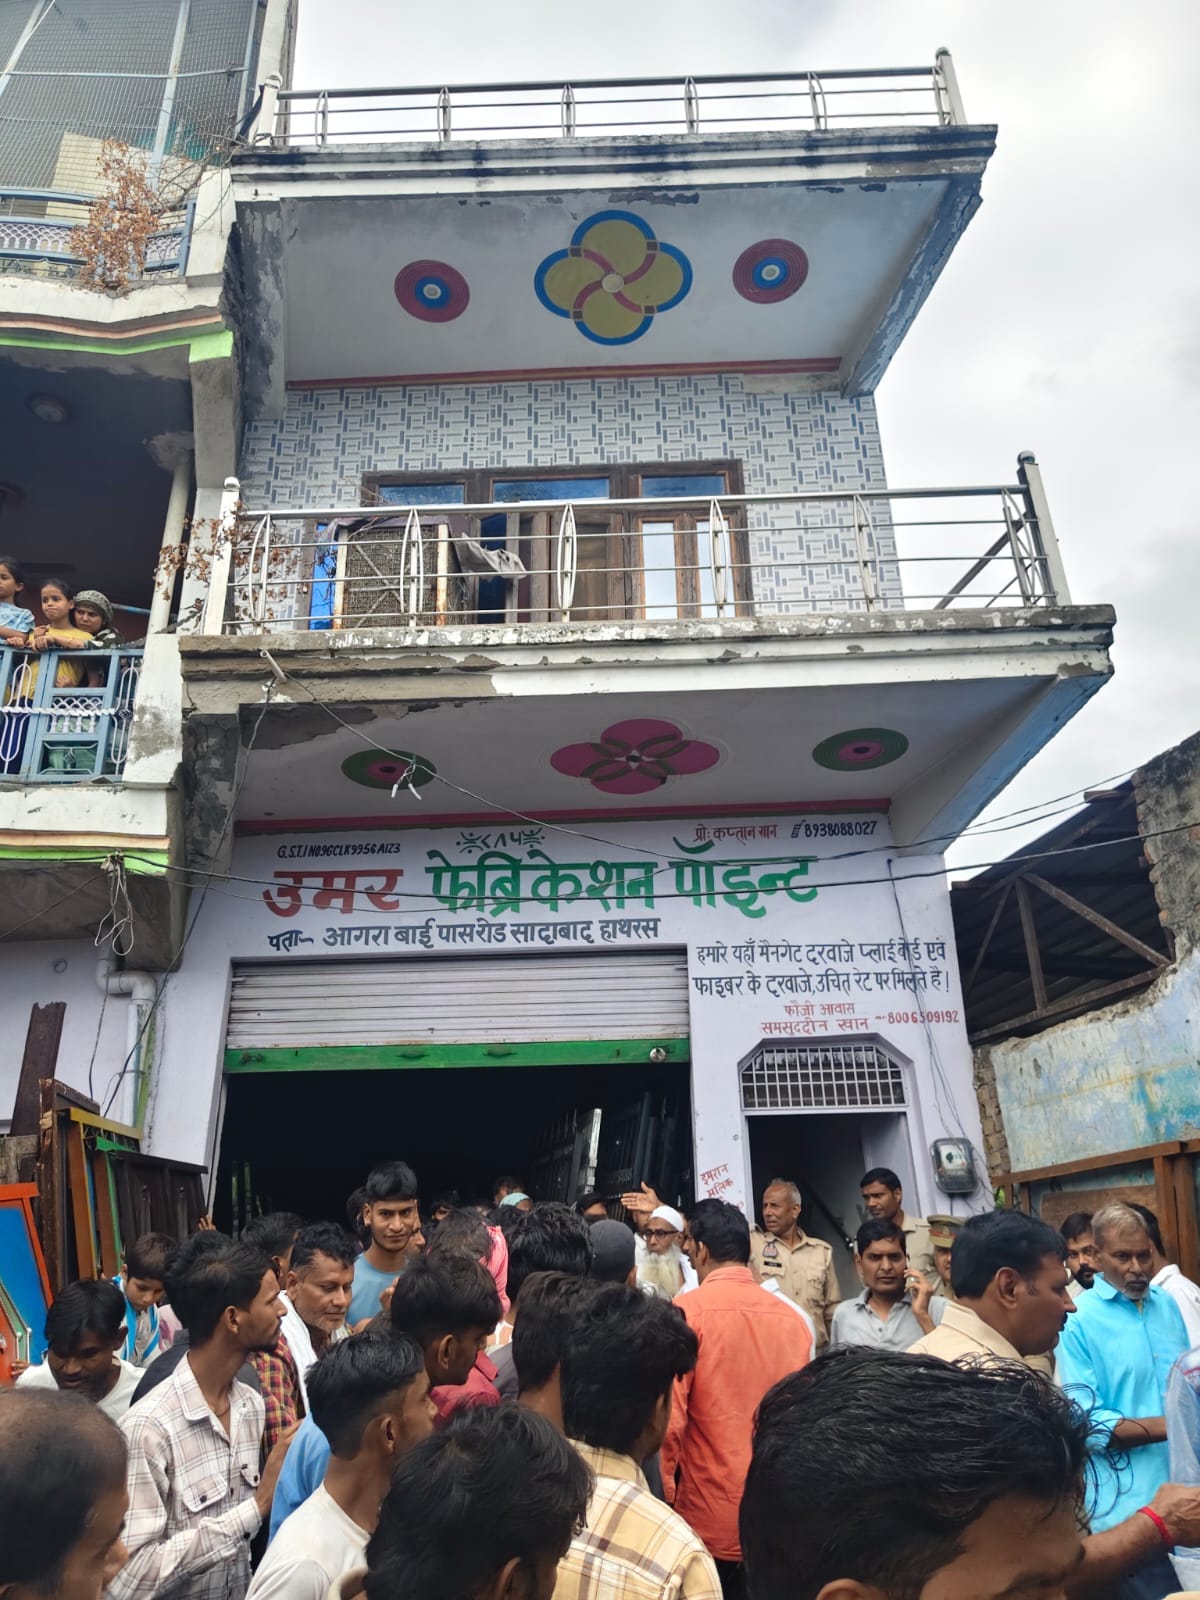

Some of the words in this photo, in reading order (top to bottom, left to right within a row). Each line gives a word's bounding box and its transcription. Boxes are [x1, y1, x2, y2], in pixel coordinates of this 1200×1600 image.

[804, 820, 877, 838] 8938088027
[262, 868, 404, 918] उमर
[323, 925, 391, 947] आगरा
[509, 920, 595, 945] सादाबाद
[599, 917, 661, 943] हाथरस
[696, 940, 729, 966] हमारे
[804, 938, 855, 966] दरवाजे
[923, 937, 946, 961] एवं
[692, 975, 744, 998] फाइबर
[746, 970, 761, 995] के
[852, 967, 873, 992] रेट
[819, 1002, 856, 1016] आवास
